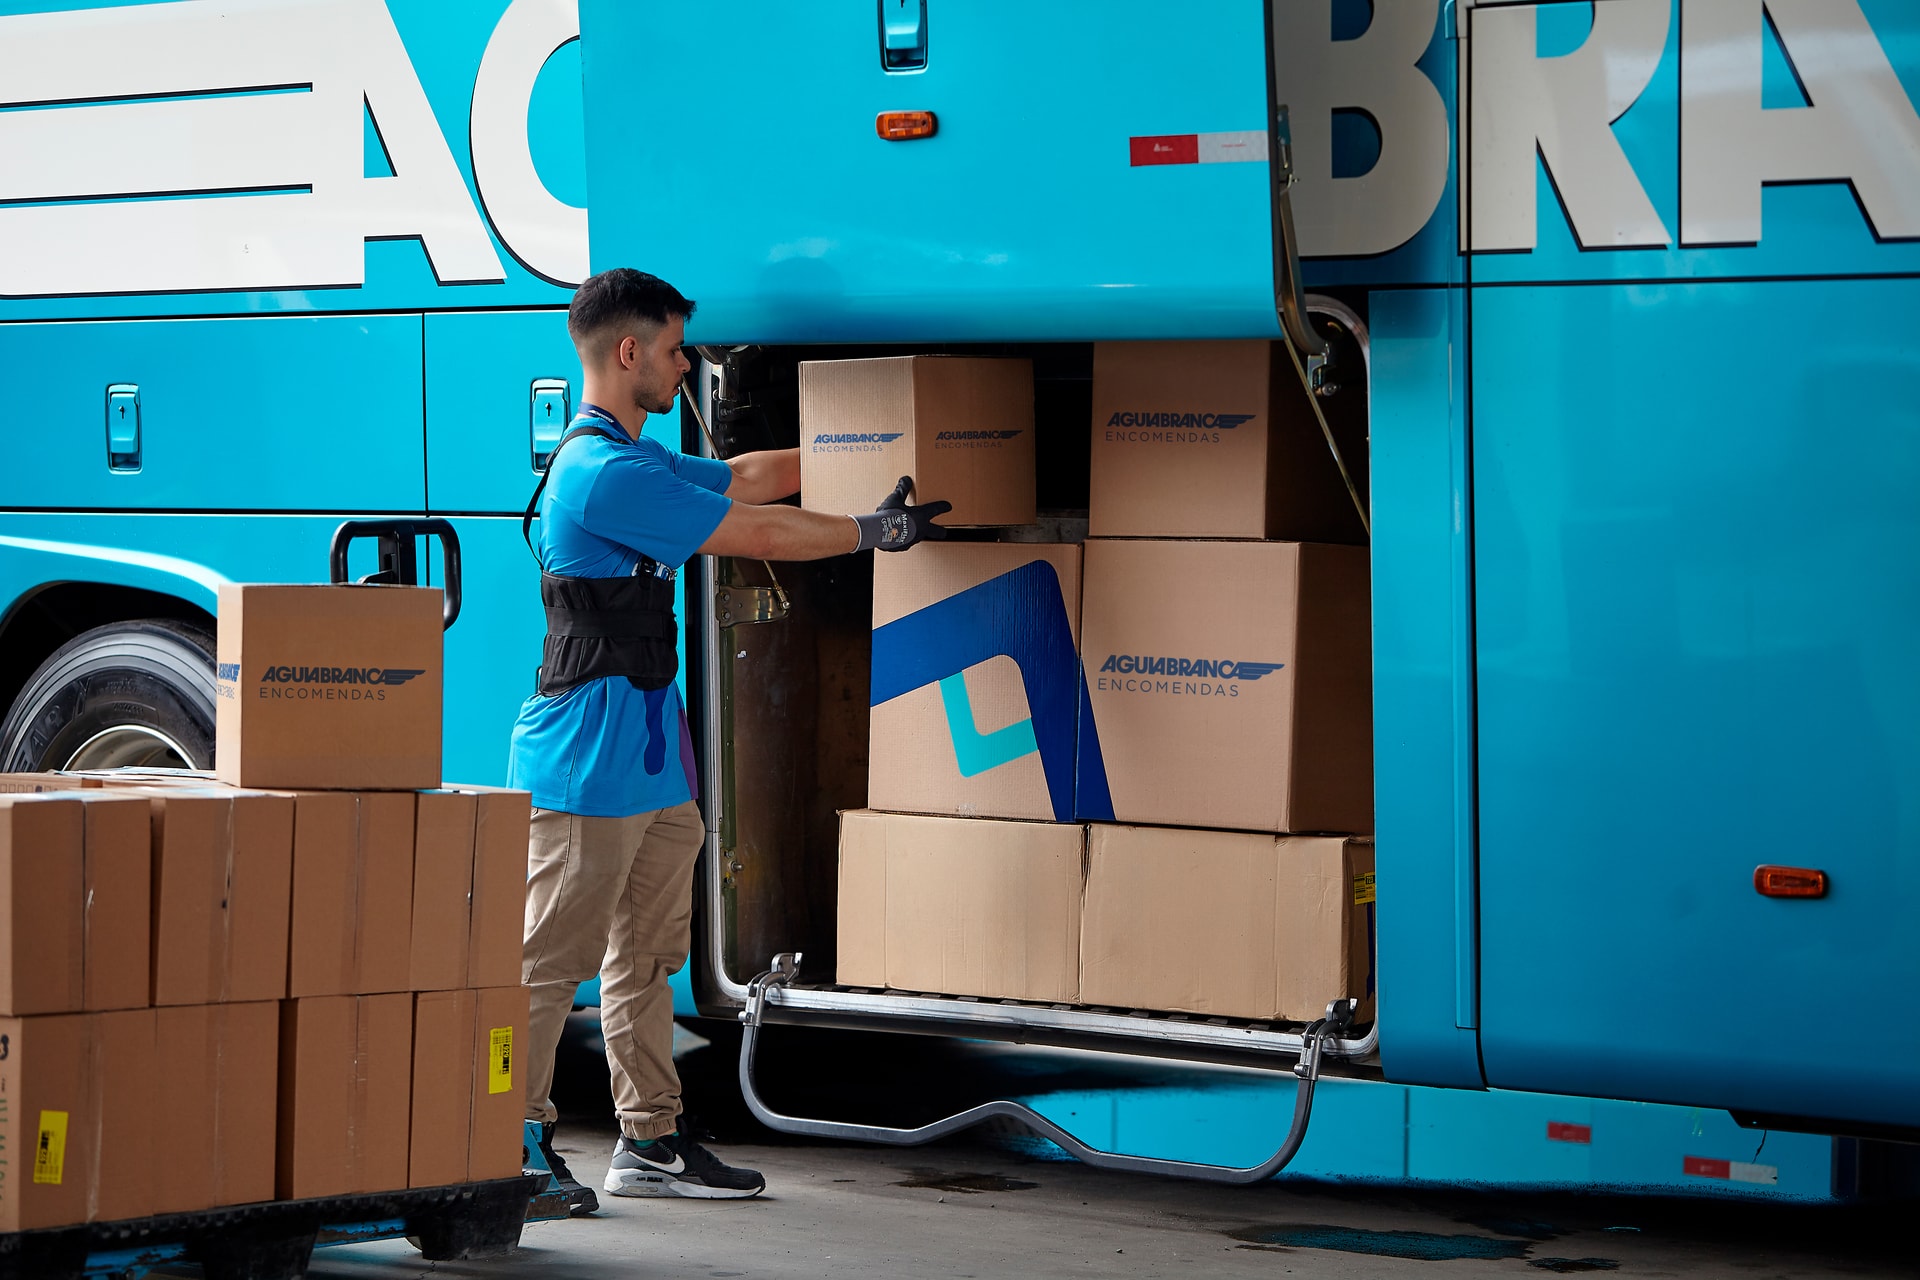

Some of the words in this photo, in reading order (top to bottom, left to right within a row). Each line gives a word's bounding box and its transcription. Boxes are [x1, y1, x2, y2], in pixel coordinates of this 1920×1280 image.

[1106, 411, 1256, 429] AGUIABRANCA
[813, 432, 904, 444] AGUIABRANCA
[935, 429, 1024, 441] AGUIABRANCA
[1105, 431, 1221, 443] ENCOMENDAS
[812, 444, 883, 453] ENCOMENDAS
[935, 441, 1003, 450] ENCOMENDAS
[1100, 654, 1285, 680] AGUIABRANCA
[261, 665, 426, 685] AGUIABRANCA
[259, 687, 386, 701] ENCOMENDAS
[1097, 678, 1239, 697] ENCOMENDAS
